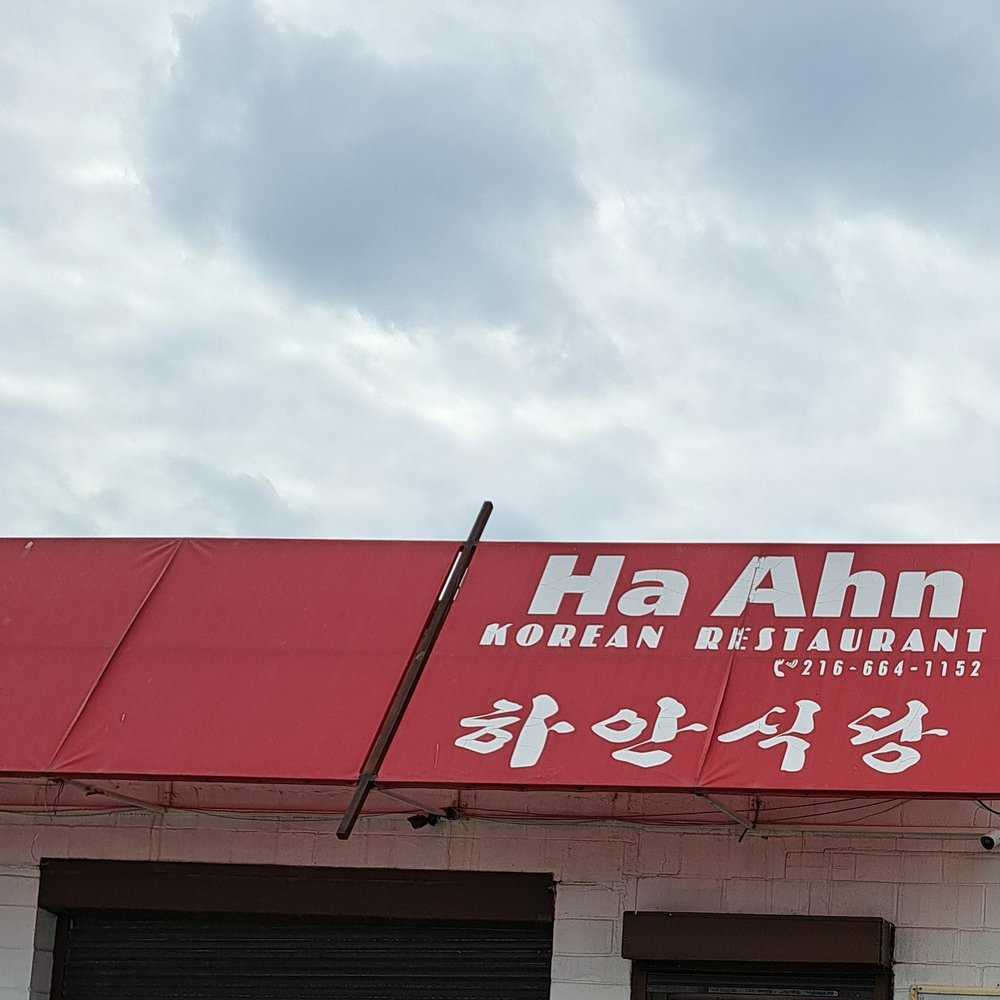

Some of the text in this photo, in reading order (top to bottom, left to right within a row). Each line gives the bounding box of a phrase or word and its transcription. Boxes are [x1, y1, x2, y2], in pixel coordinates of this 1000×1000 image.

[527, 552, 965, 619] Ha Ahn
[478, 622, 988, 654] KOREAN RESTAURANT
[800, 658, 983, 679] 216-664-1152
[454, 694, 949, 774] 하안식당
